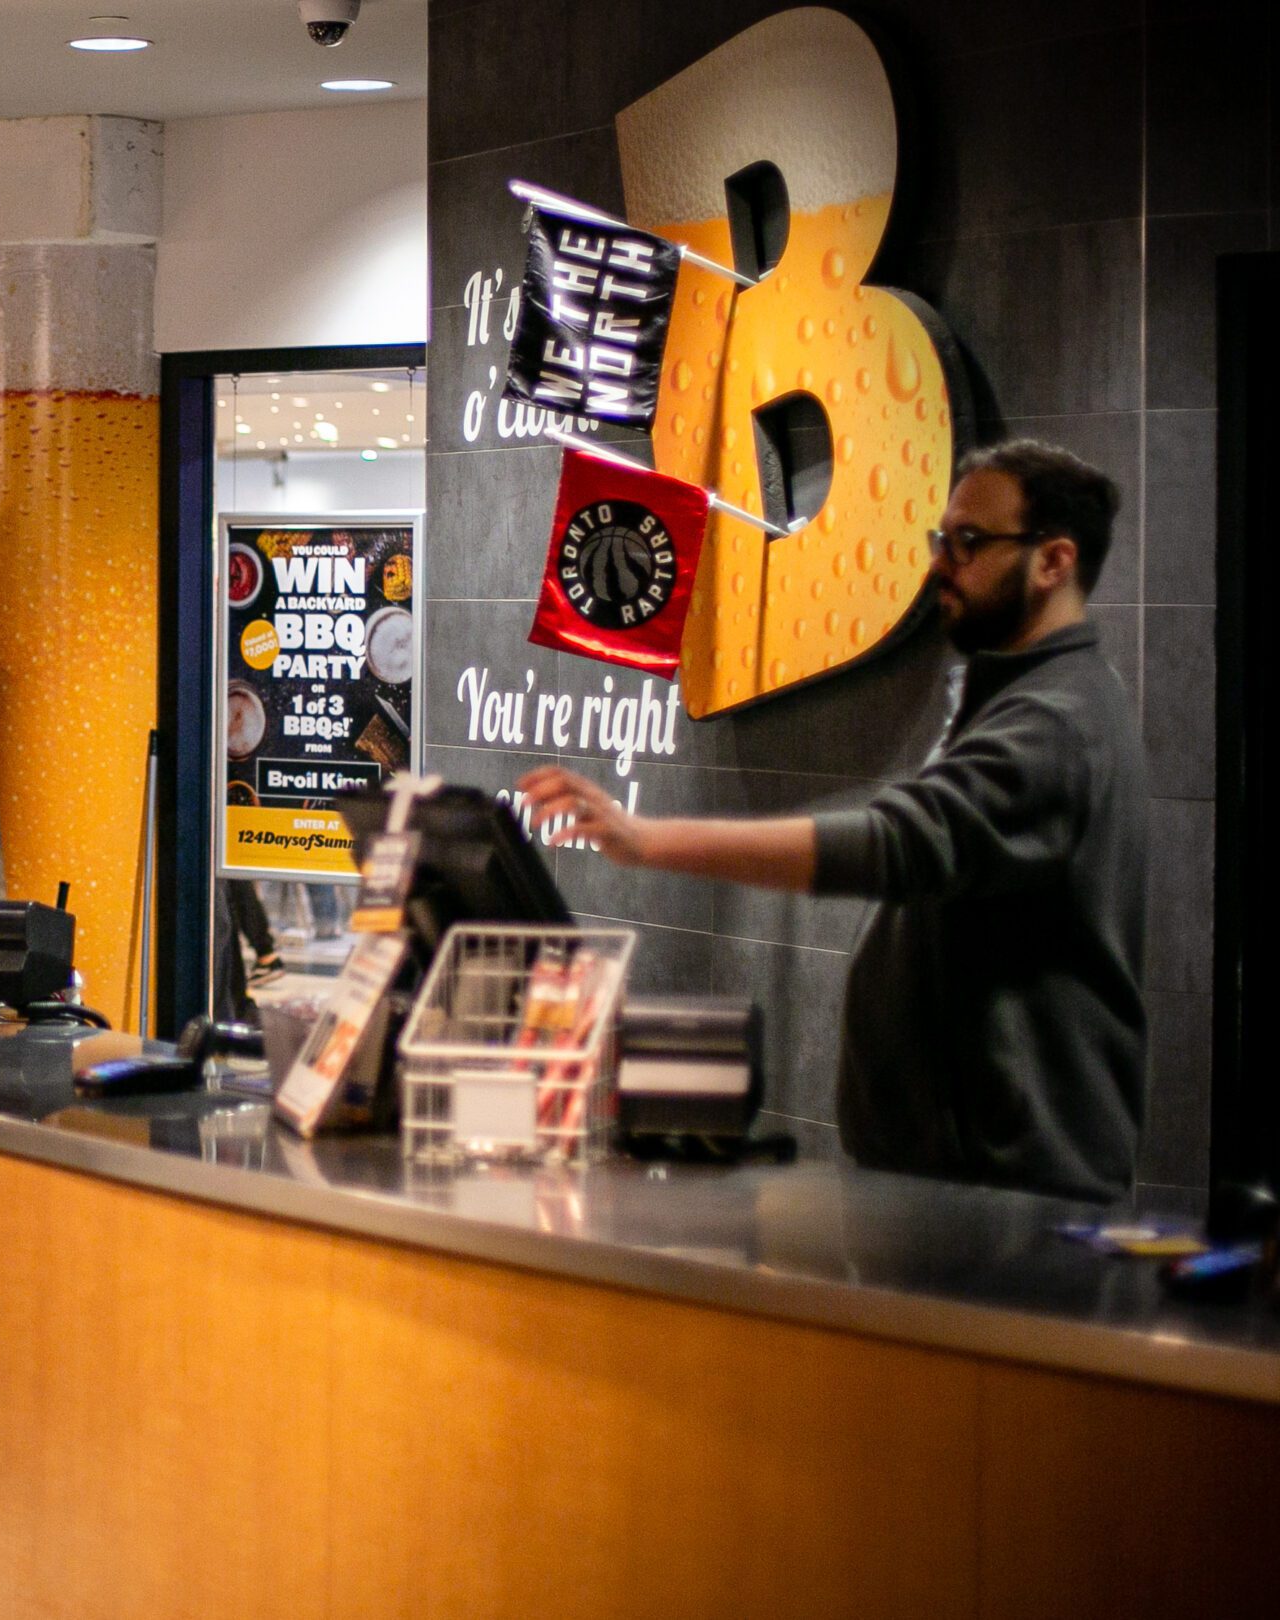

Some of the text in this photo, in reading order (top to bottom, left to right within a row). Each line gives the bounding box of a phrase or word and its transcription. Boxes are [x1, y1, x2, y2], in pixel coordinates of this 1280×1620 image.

[533, 229, 606, 401] WE THE
[584, 238, 655, 414] NORTH
[292, 545, 349, 556] YOU COULD
[561, 503, 613, 615] TORONTO
[272, 557, 366, 594] WIN
[622, 514, 674, 624] RAPTORS
[275, 596, 366, 611] A BACKYARD
[274, 613, 367, 657] BBQ
[272, 654, 367, 680] PARTY
[311, 684, 326, 693] OR
[292, 694, 344, 716] 1 of 3
[457, 666, 680, 777] You're right
[305, 743, 332, 753] FROM
[267, 769, 318, 789] Broil
[293, 818, 340, 831] ENTER AT
